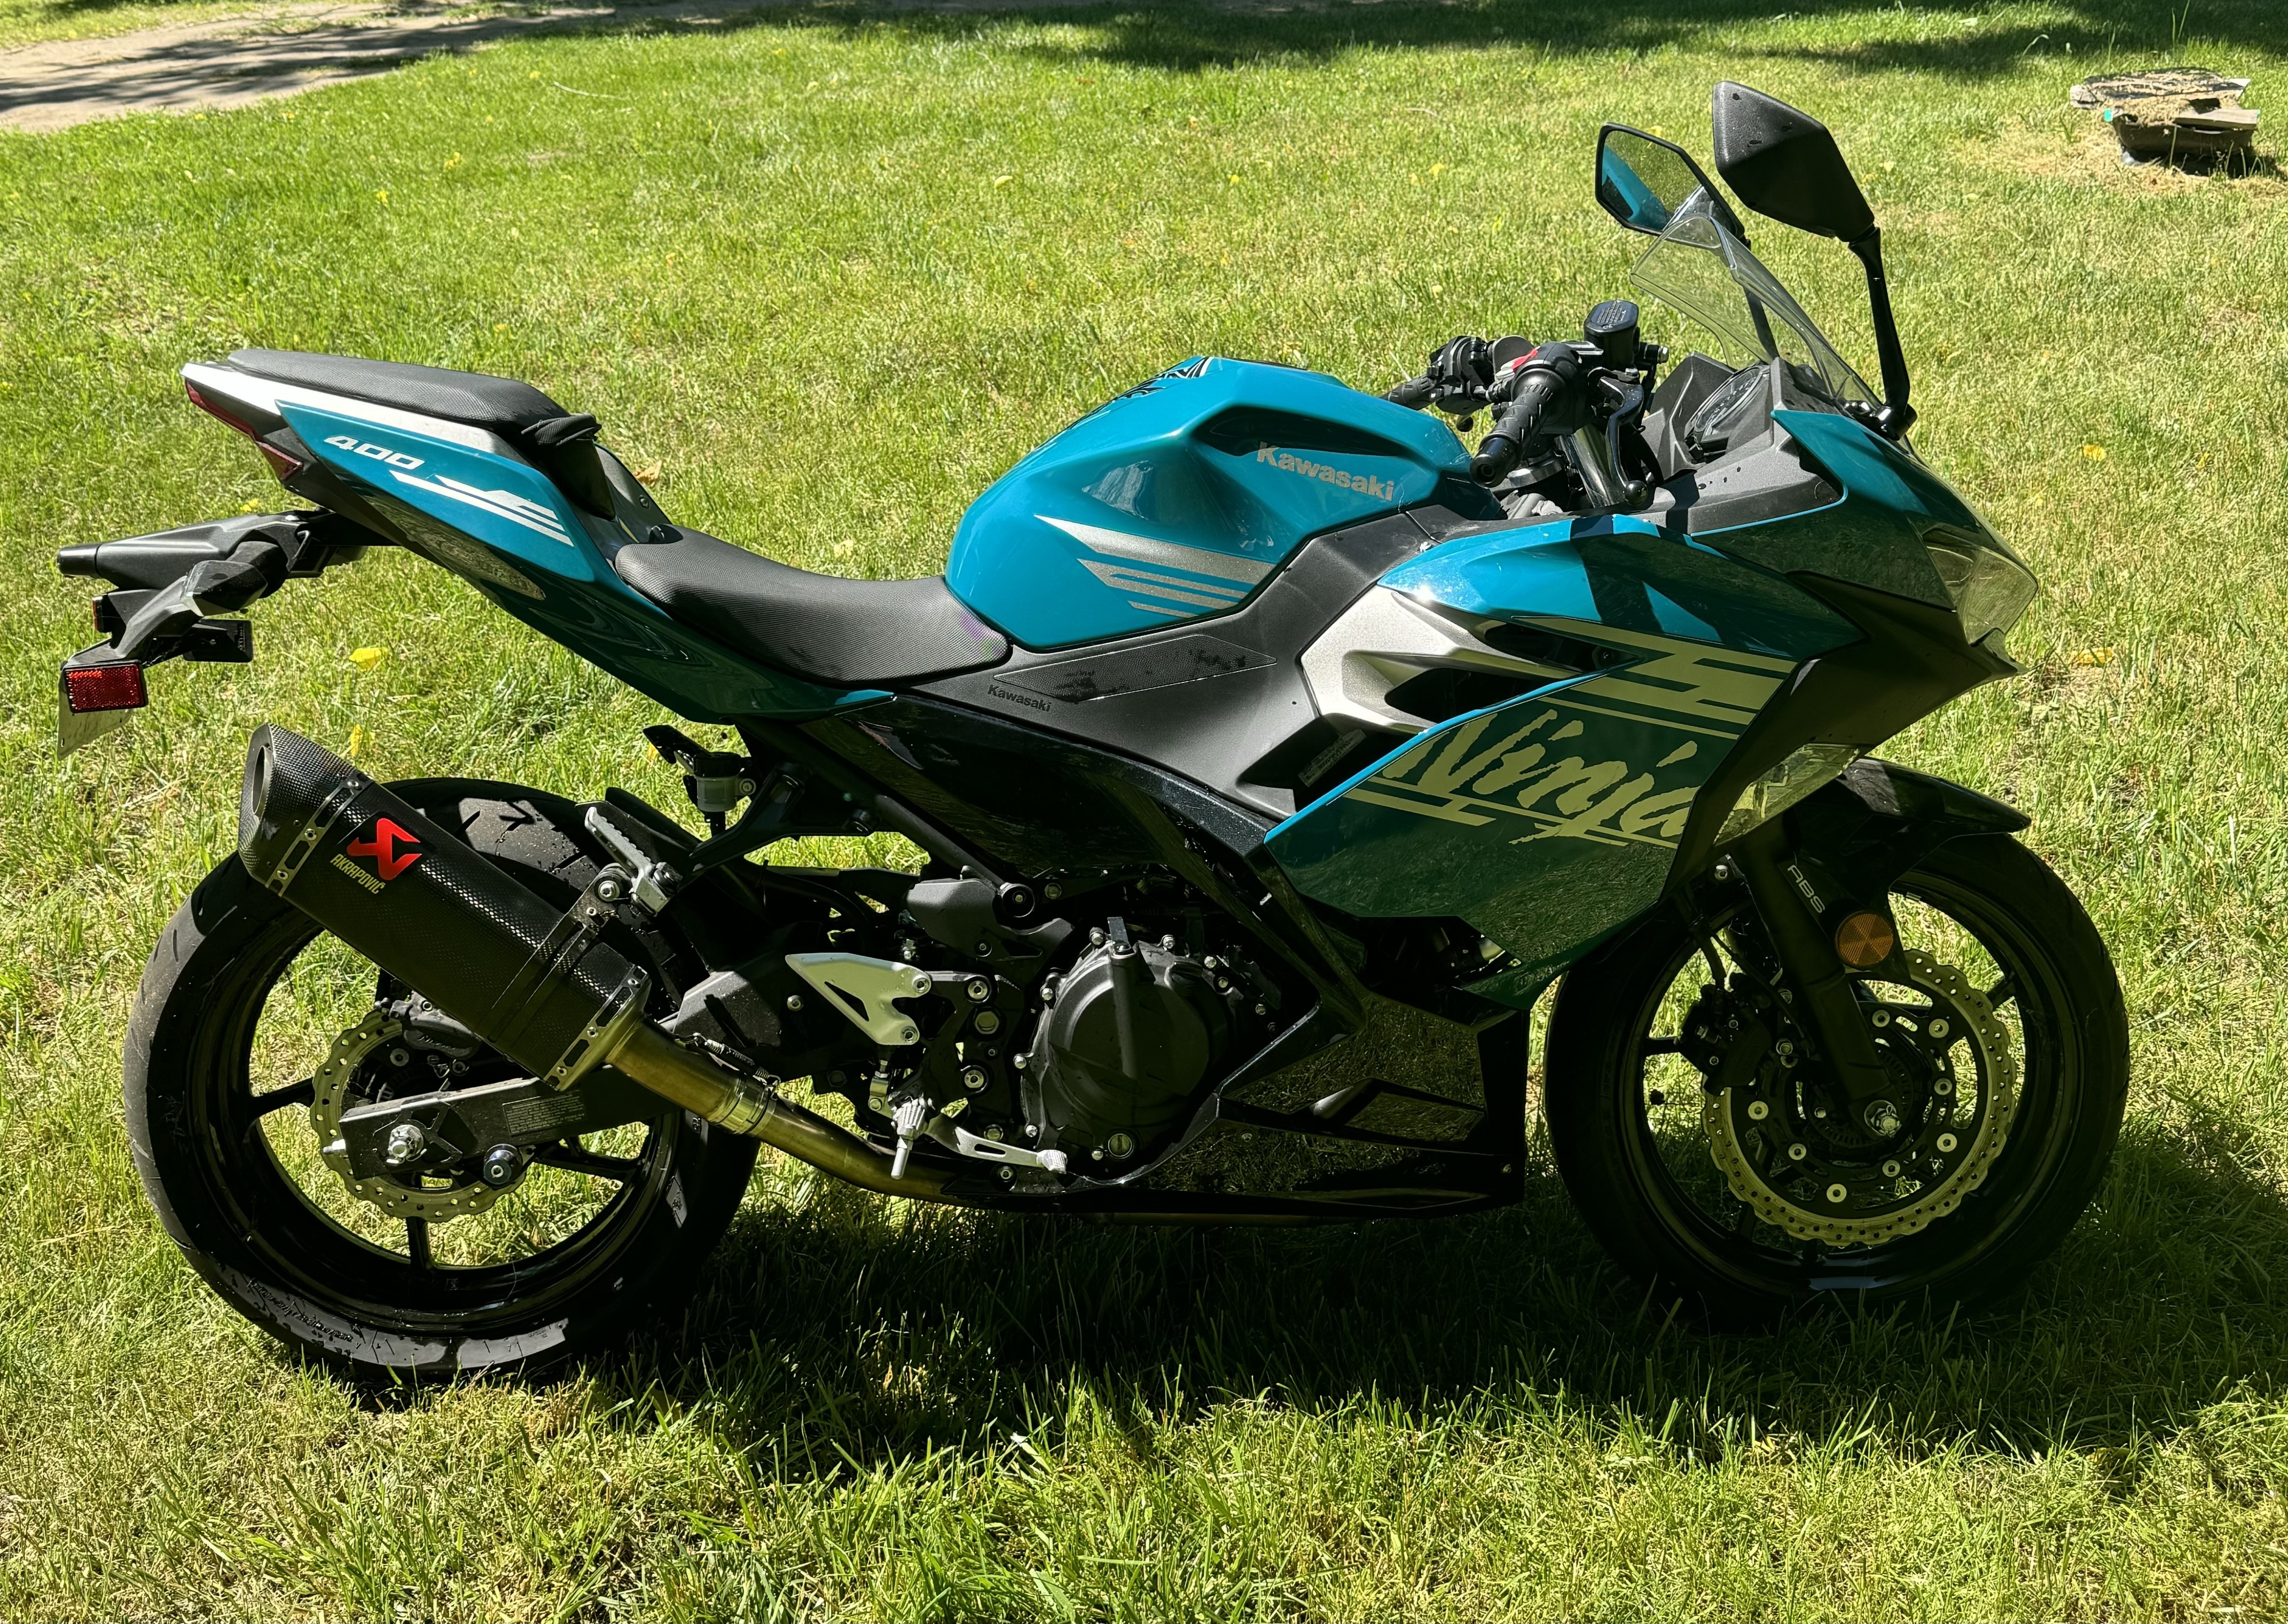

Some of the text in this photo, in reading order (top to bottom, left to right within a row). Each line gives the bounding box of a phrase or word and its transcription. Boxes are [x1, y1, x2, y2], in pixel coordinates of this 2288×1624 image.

[324, 435, 425, 469] 400
[1257, 441, 1394, 501] Kawasaki
[988, 684, 1052, 712] Kawasaki
[1382, 709, 1702, 845] Ninja
[330, 853, 386, 894] AKRAPOVIČ
[1787, 865, 1825, 913] ABS
